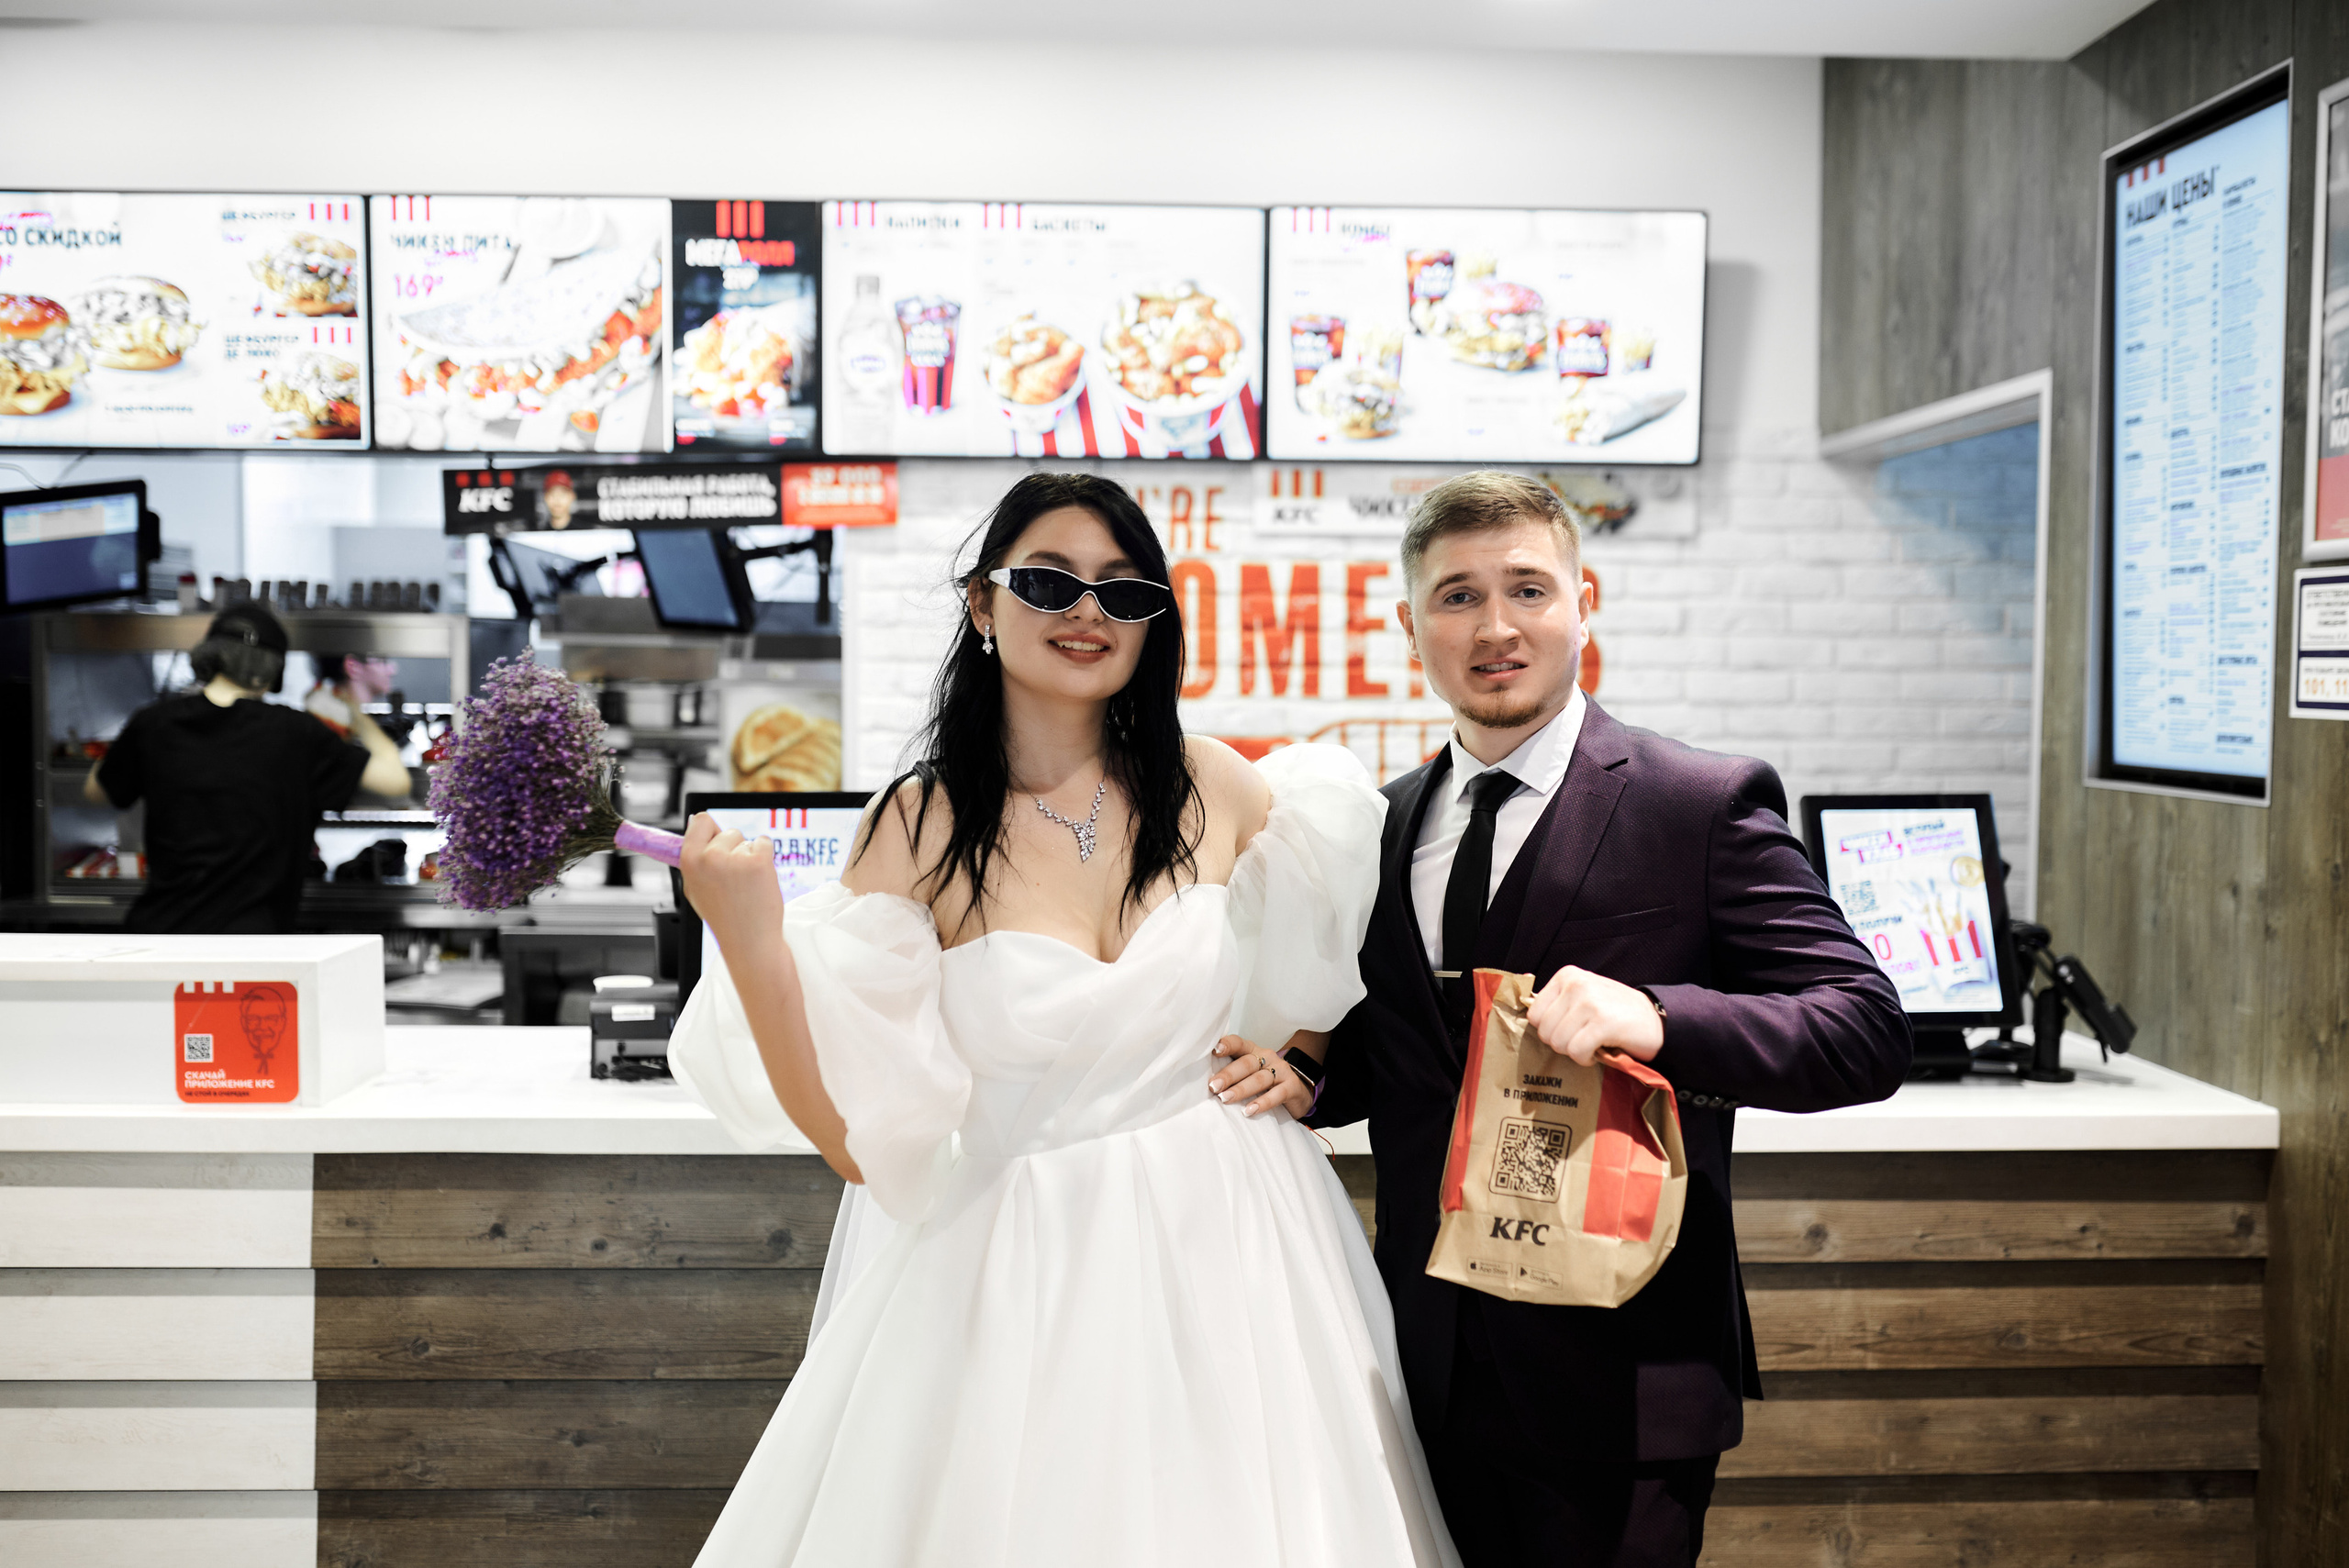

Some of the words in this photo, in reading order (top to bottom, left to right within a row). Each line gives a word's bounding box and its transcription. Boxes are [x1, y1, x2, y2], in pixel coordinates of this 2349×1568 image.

[2126, 188, 2168, 228] НАШИ
[25, 221, 122, 249] СКИДКОЙ
[458, 486, 514, 513] KFC
[1272, 506, 1319, 524] KFC
[2335, 677, 2349, 695] 11
[806, 837, 840, 855] KFC
[184, 1069, 226, 1080] СКАЧАЙ
[1523, 1074, 1562, 1088] ЗАКАЖИ
[184, 1079, 254, 1089] ПРИЛОЖЕНИЕ
[255, 1079, 275, 1089] KFC
[1504, 1088, 1510, 1098] В
[1513, 1089, 1579, 1108] ПРИЛОЖЕНИИ
[1489, 1216, 1550, 1246] KFC
